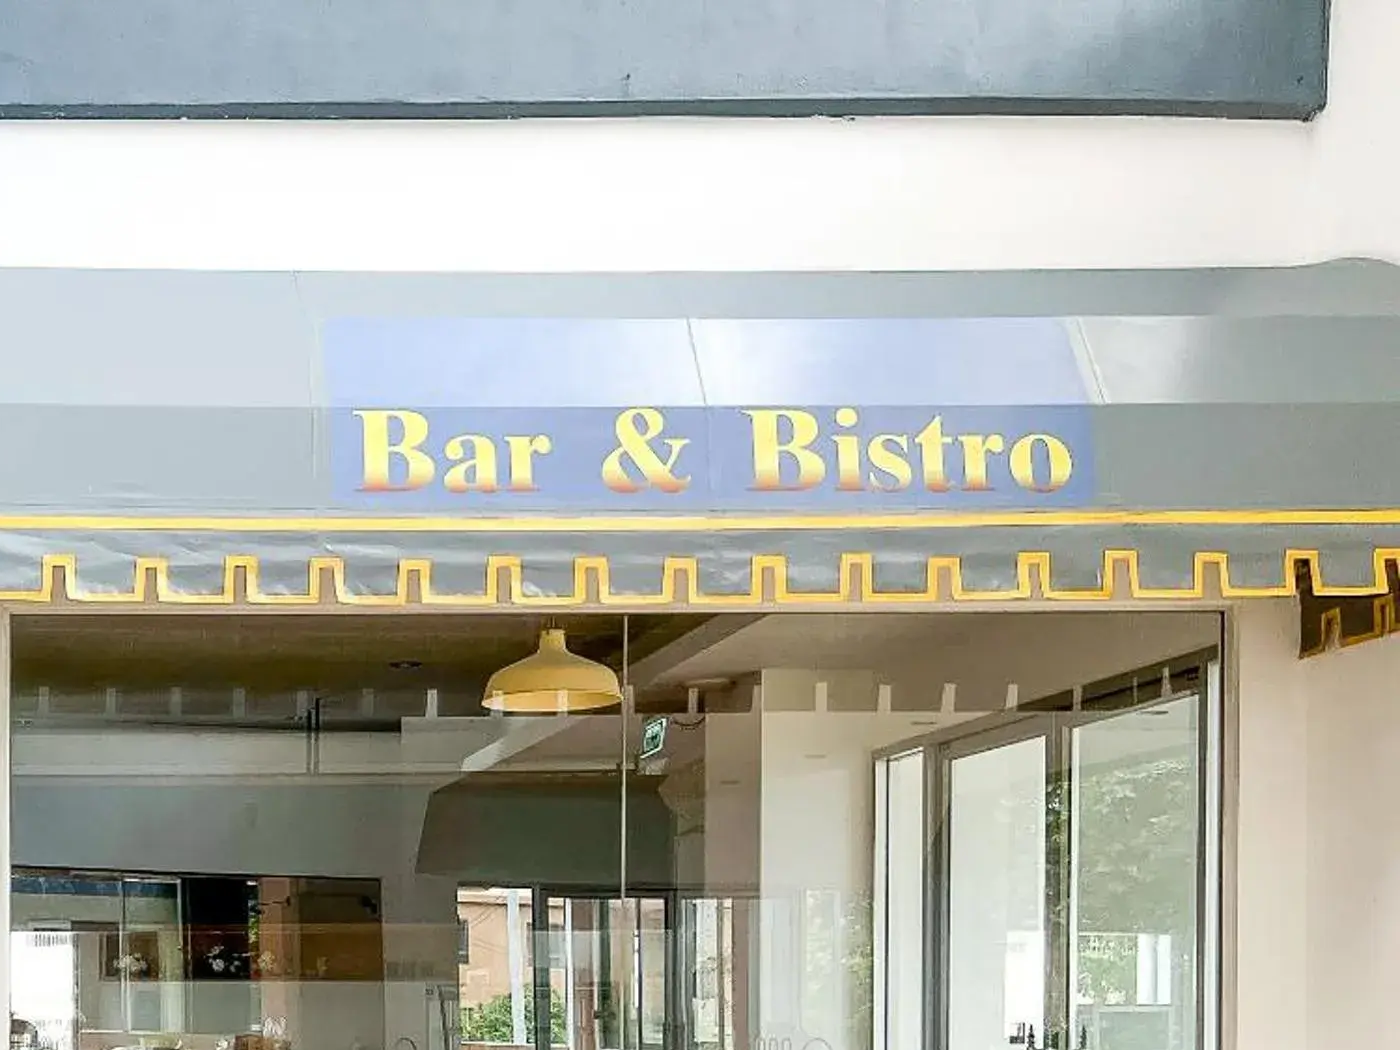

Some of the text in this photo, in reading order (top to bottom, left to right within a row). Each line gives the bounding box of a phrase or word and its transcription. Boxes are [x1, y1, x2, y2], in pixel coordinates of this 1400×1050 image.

[352, 406, 1074, 494] Bar & Bistro
